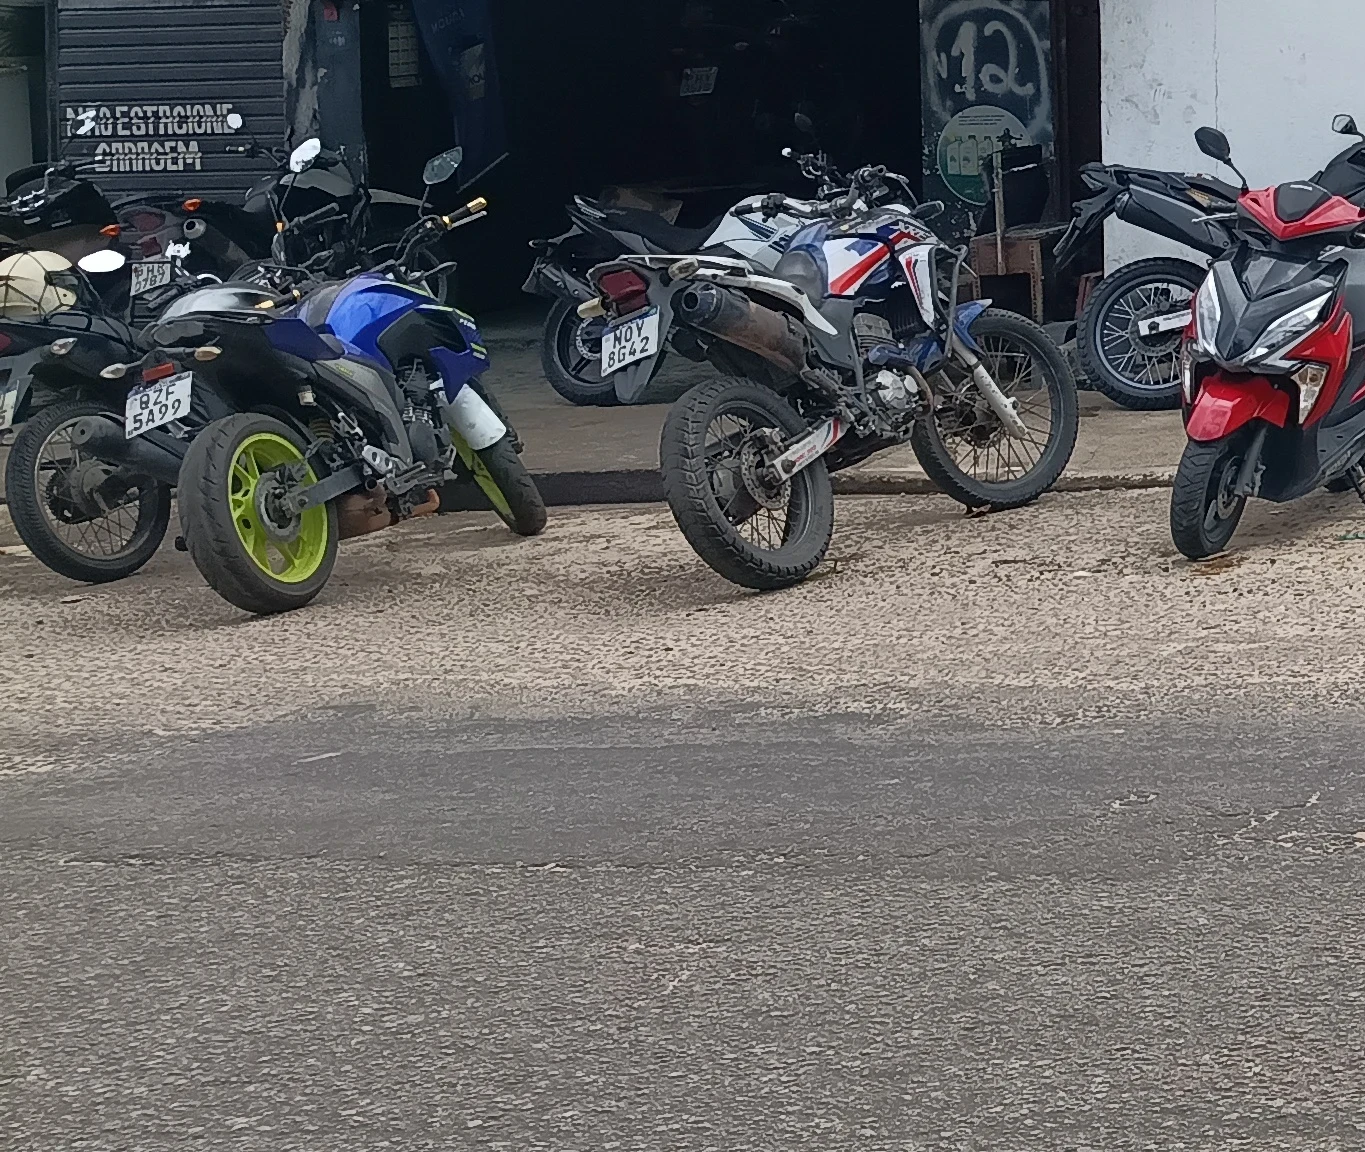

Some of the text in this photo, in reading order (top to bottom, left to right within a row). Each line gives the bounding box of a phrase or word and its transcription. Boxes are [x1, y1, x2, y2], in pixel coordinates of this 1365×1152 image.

[95, 140, 202, 172] GARAGEM
[613, 319, 645, 349] NOY
[607, 335, 650, 369] 8G42
[132, 398, 182, 432] 5A99
